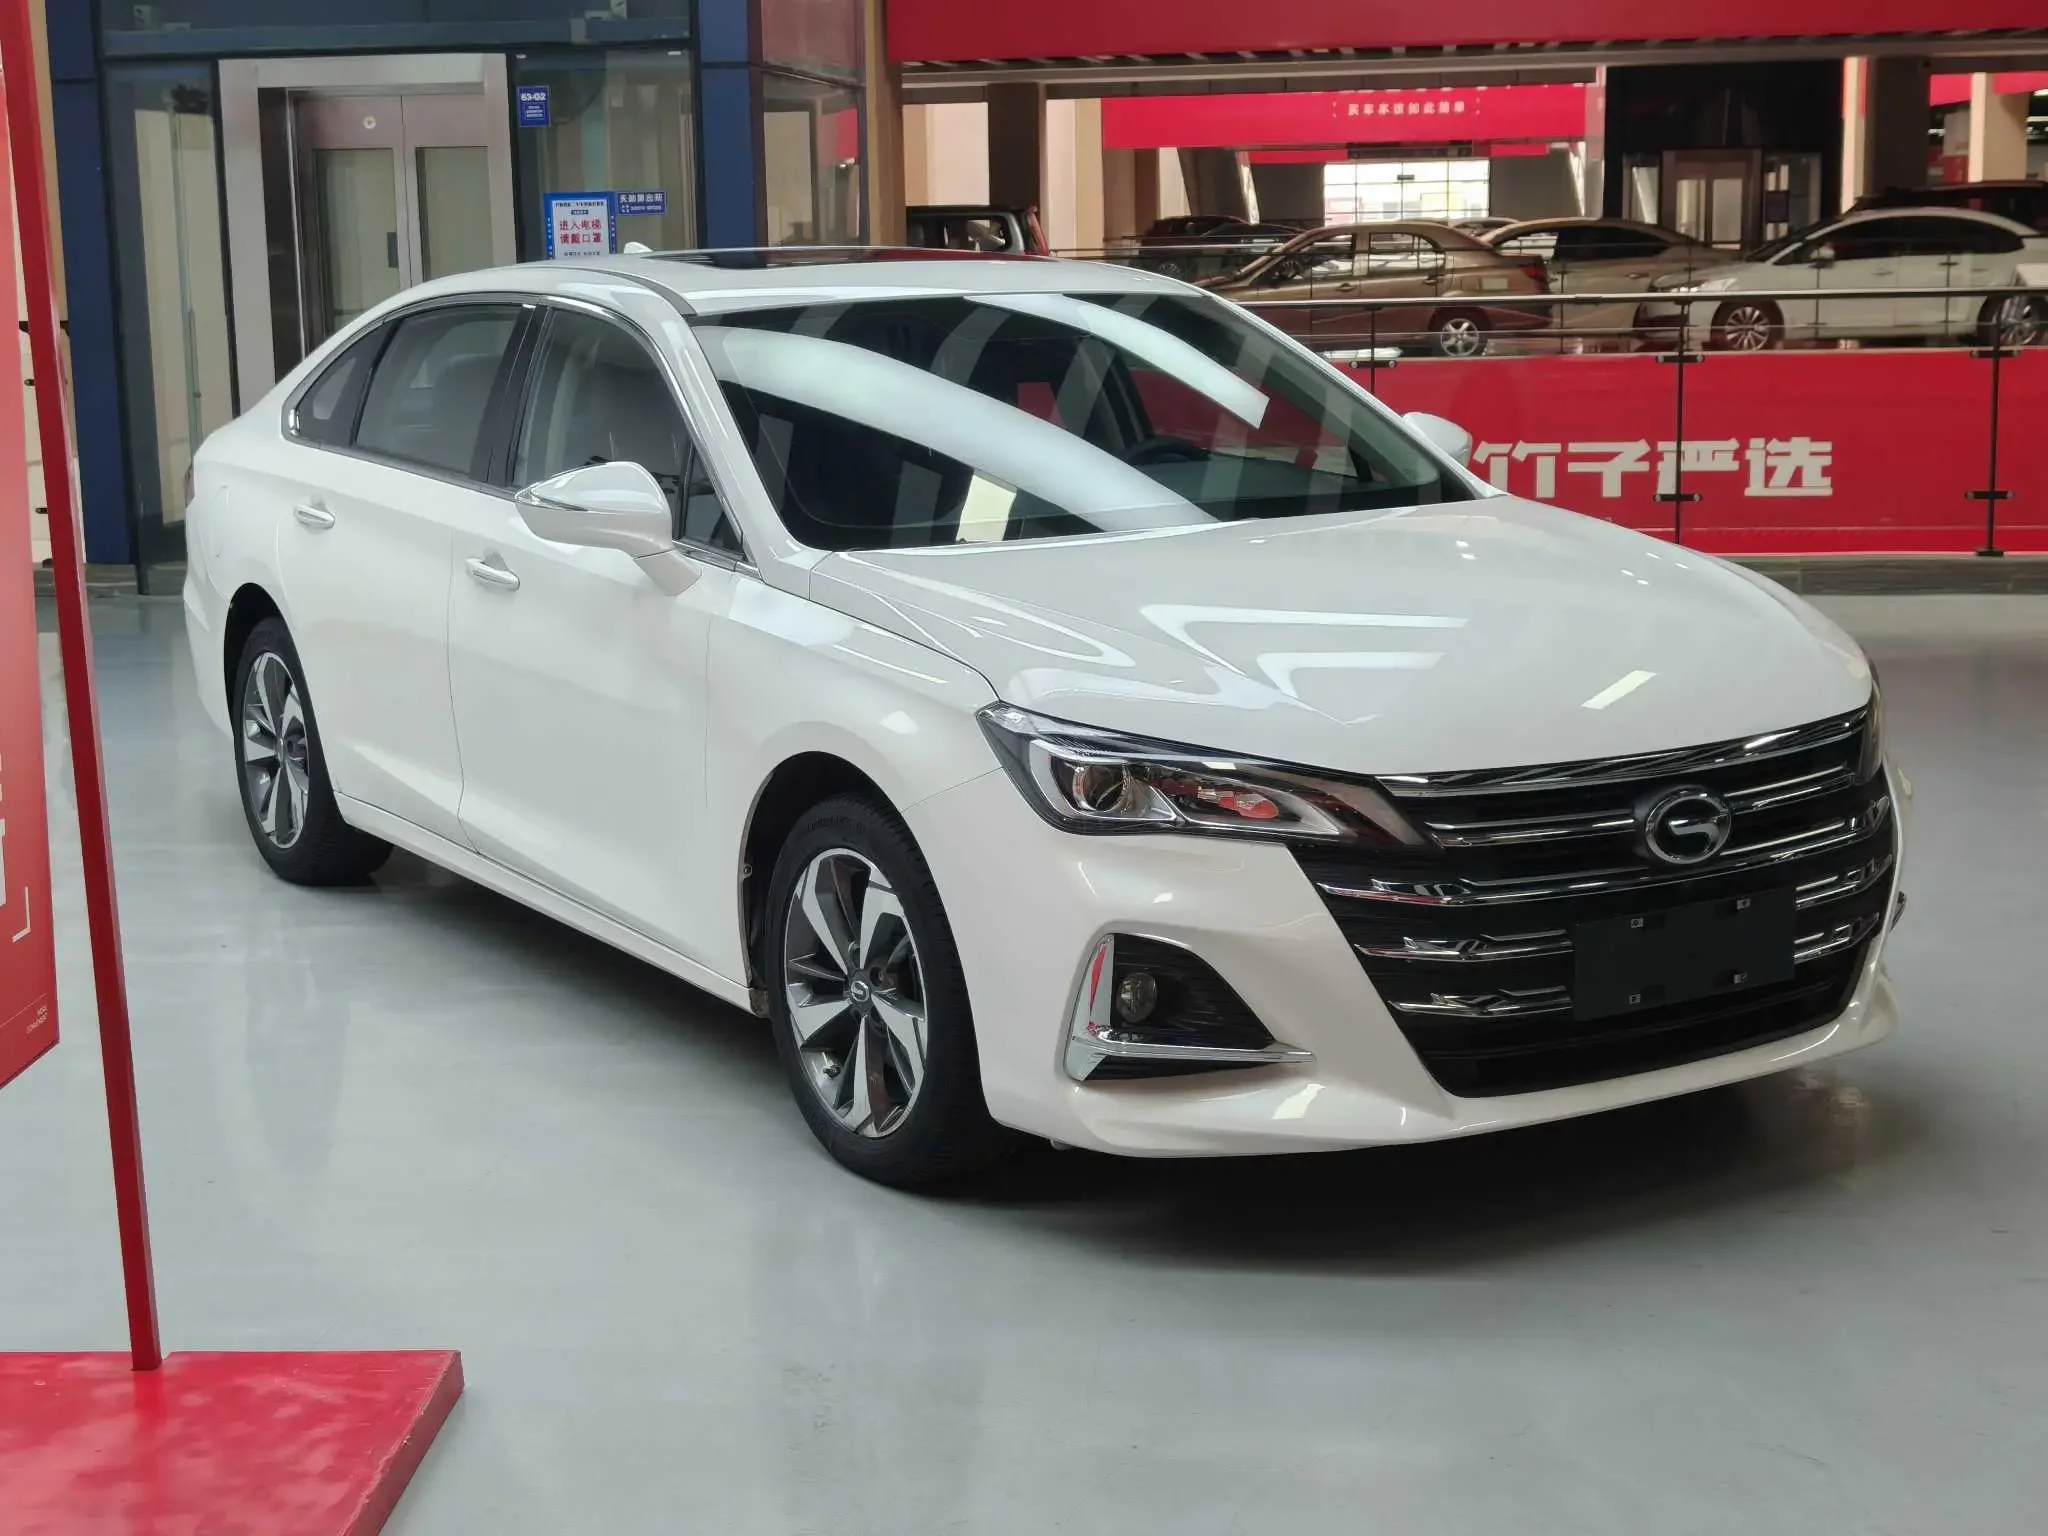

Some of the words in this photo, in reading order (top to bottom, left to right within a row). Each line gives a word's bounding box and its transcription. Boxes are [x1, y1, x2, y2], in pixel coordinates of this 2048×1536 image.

[559, 219, 602, 231] 进入电梯
[560, 232, 602, 245] 请戴口罩
[1473, 436, 1833, 498] 竹子严选
